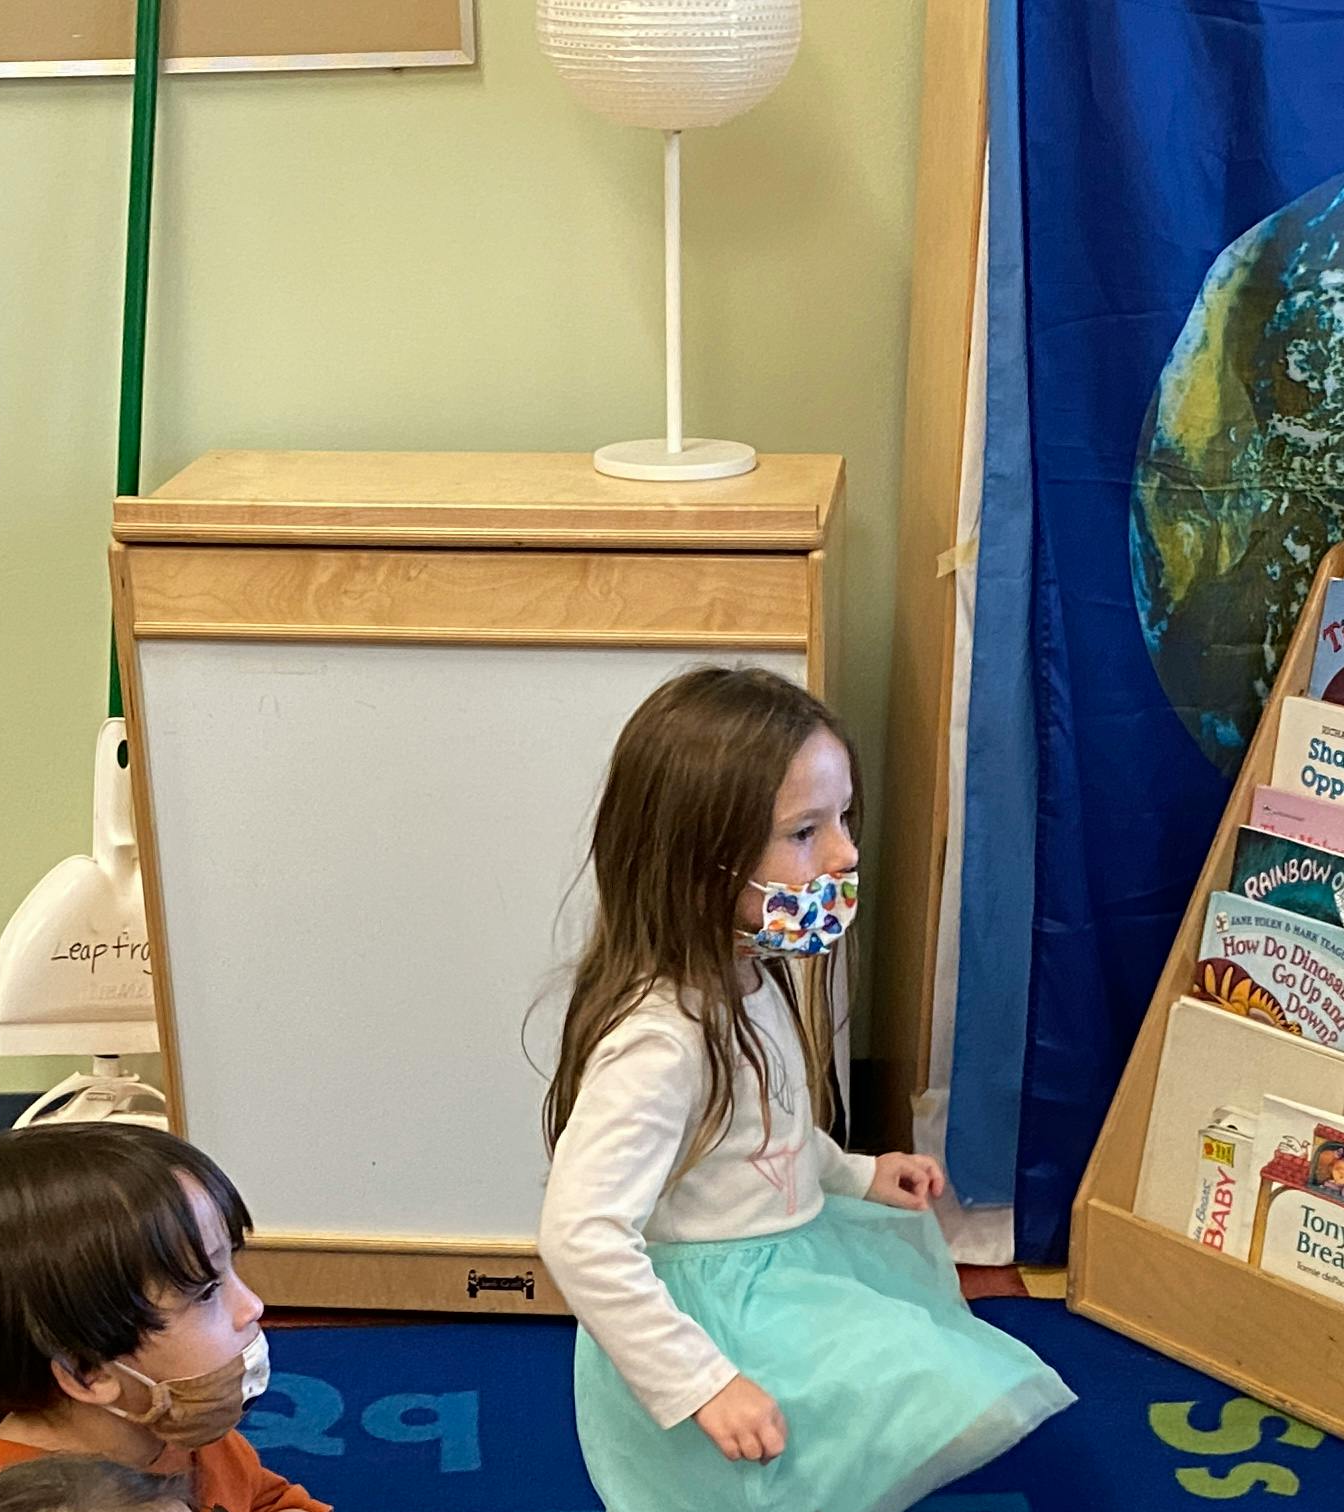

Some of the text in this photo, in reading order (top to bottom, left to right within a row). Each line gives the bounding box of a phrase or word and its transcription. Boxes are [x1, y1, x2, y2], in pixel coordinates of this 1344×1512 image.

[1244, 859, 1332, 899] RAINBOW
[1221, 936, 1259, 958] How
[1263, 936, 1287, 960] Do
[1231, 916, 1253, 925] JANE
[1254, 916, 1282, 931] YOLEN
[1285, 923, 1291, 933] &
[1293, 925, 1319, 943] MARK
[1272, 963, 1296, 988] Go
[1300, 973, 1322, 1004] Up
[1285, 993, 1339, 1045] Down?
[1203, 1165, 1236, 1252] BABY
[1296, 1261, 1320, 1279] Tomie
